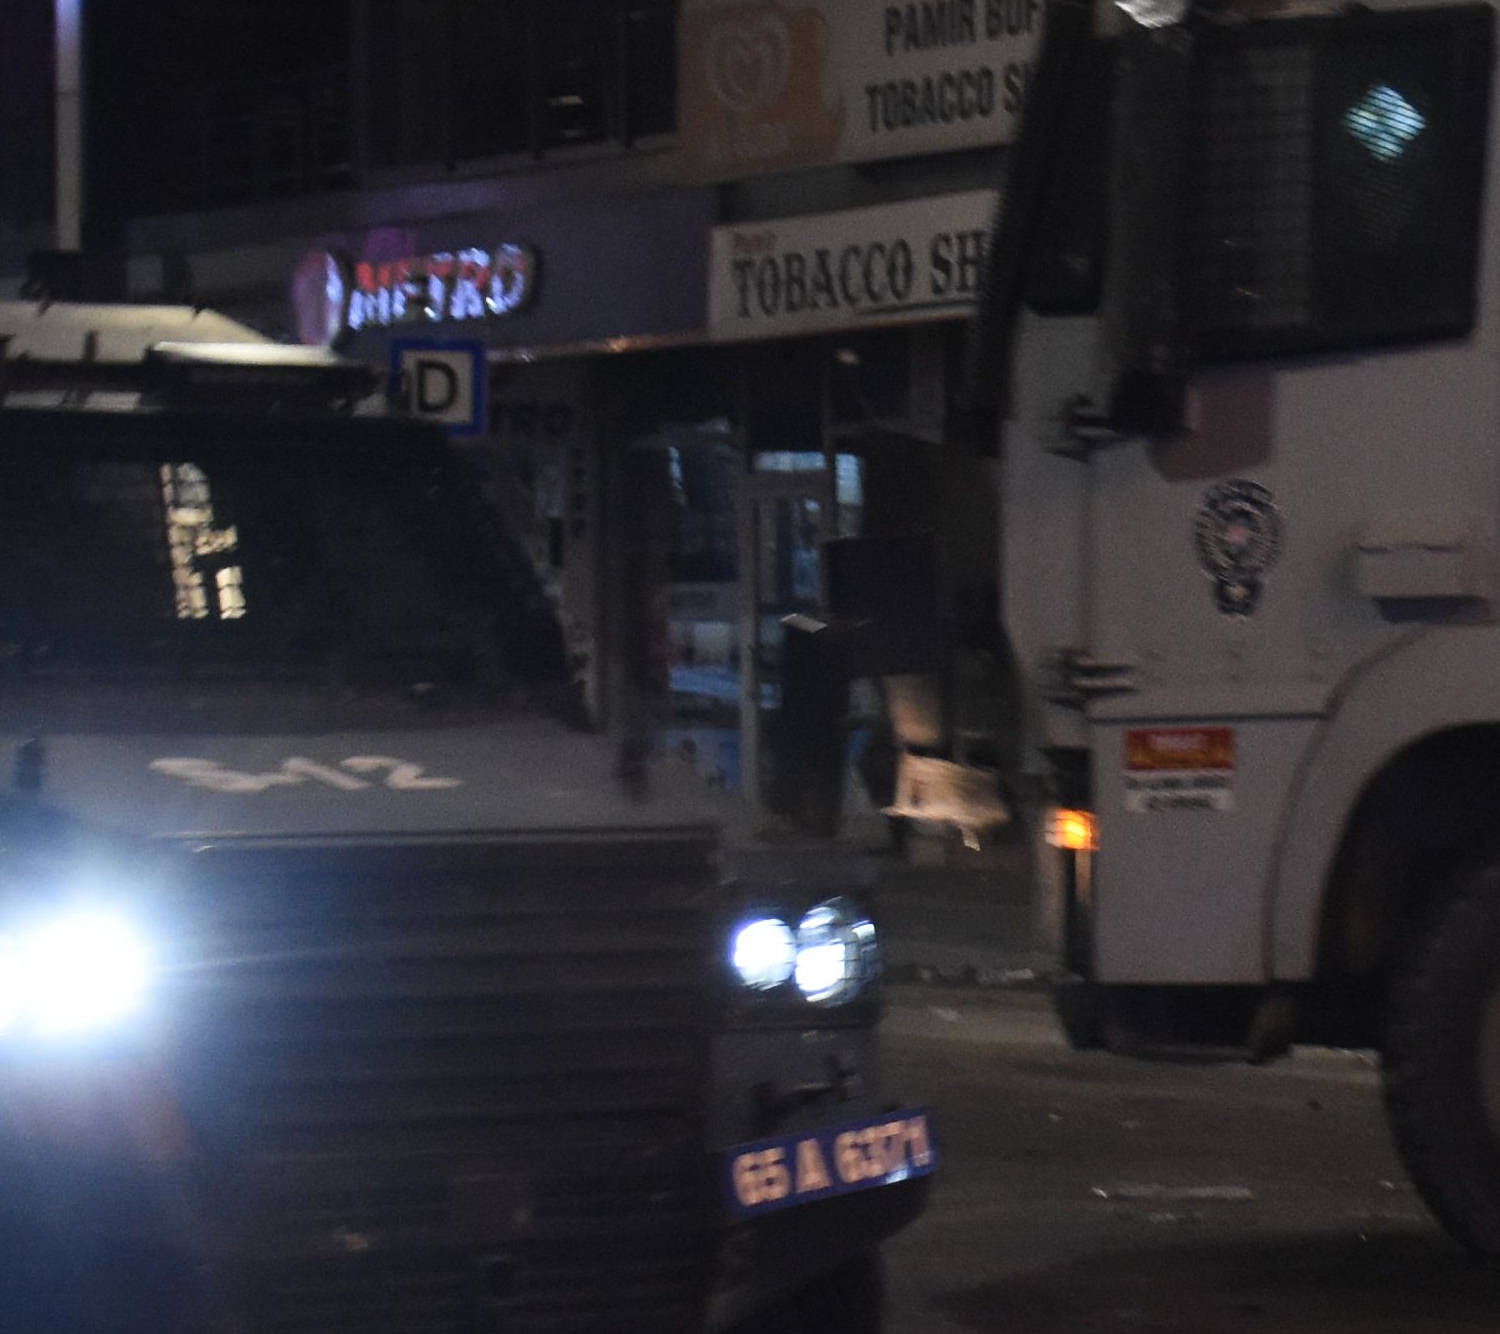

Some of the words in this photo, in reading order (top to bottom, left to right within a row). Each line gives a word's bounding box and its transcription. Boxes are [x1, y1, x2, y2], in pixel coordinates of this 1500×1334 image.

[865, 65, 996, 133] TOBACCO
[349, 242, 533, 331] METRO
[730, 238, 915, 319] TOBACCO
[930, 228, 986, 297] SH
[412, 359, 459, 413] D
